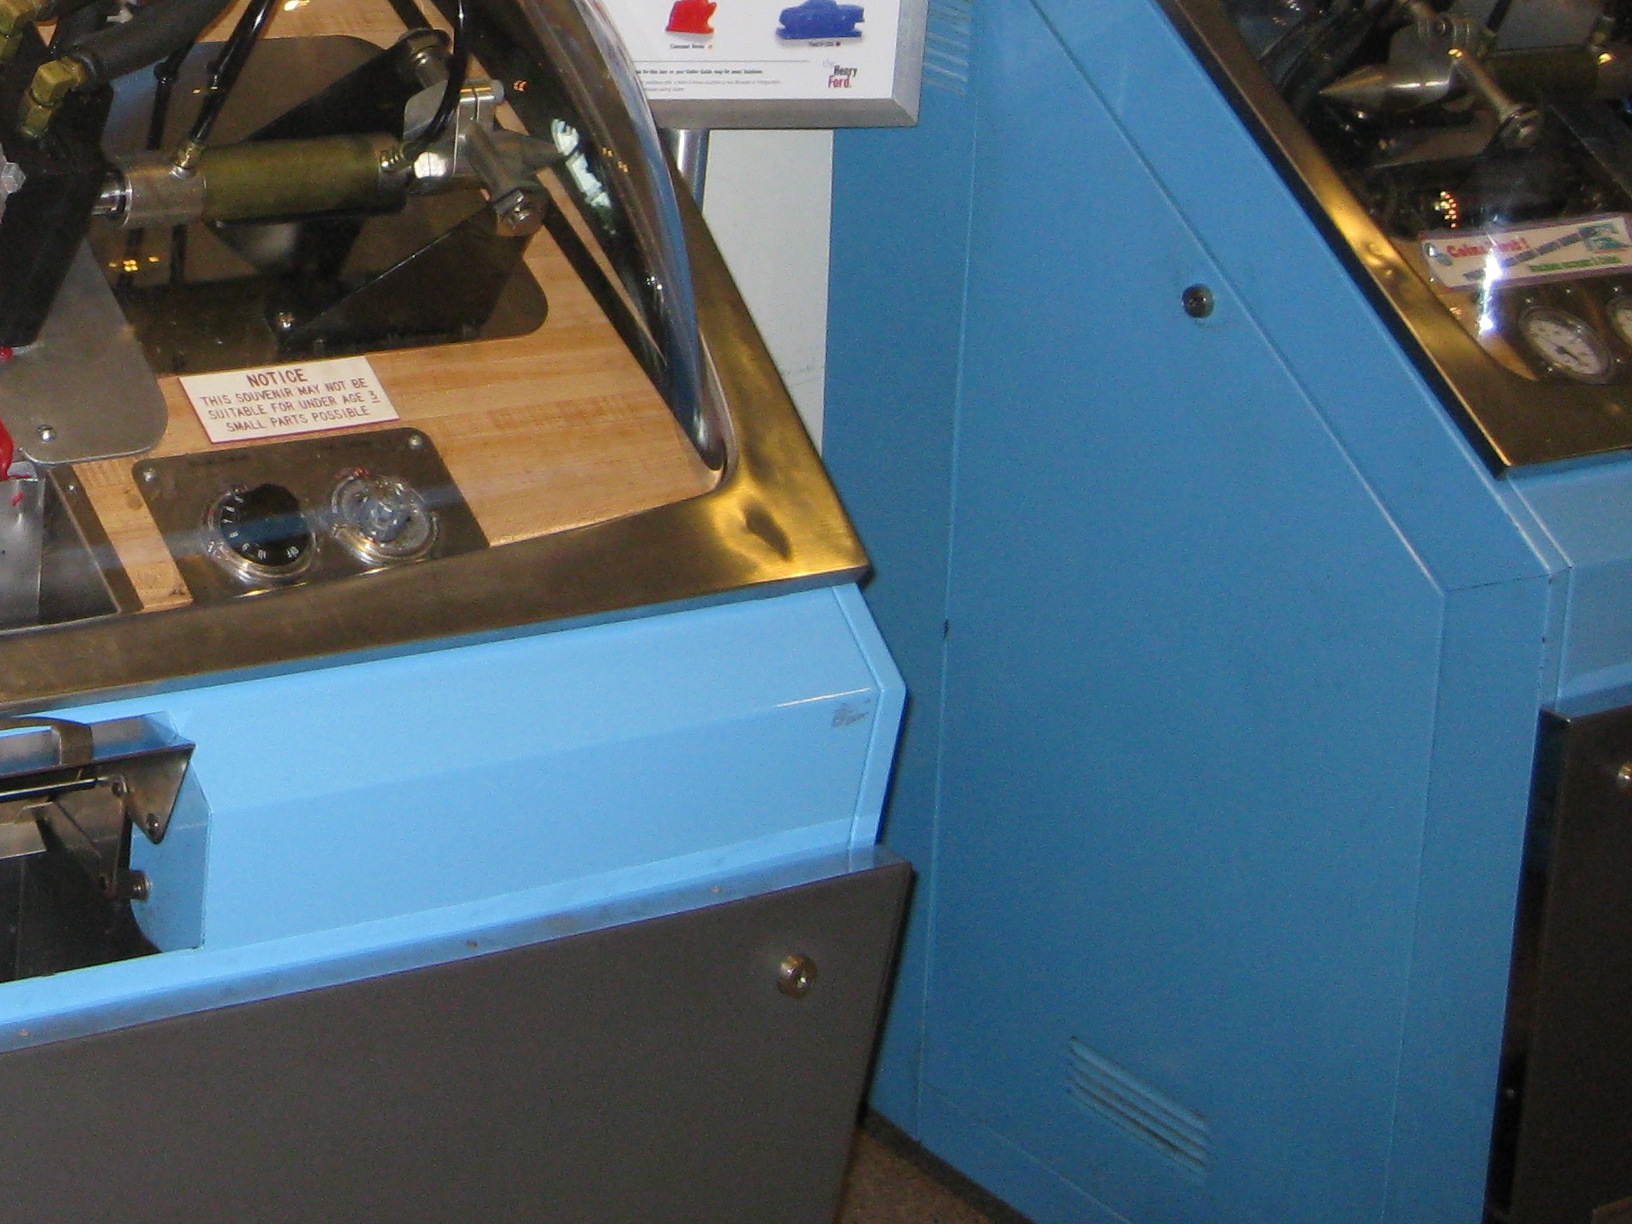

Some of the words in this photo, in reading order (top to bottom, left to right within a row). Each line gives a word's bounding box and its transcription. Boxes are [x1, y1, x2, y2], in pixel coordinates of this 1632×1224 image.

[833, 64, 858, 78] Henry
[246, 368, 308, 388] NOTICE
[200, 394, 231, 407] THIS
[235, 387, 294, 403] SOUVENIR
[297, 383, 319, 396] MAY
[324, 380, 346, 392] NOT
[350, 377, 368, 389] BE
[208, 404, 267, 420] SUITABLE
[271, 400, 296, 413] FOR
[298, 394, 337, 410] UNDER
[342, 391, 365, 403] AGE
[368, 390, 379, 401] 3
[226, 418, 267, 432] SMALL
[269, 413, 309, 428] PARTS
[311, 405, 371, 423] POSSIBLE
